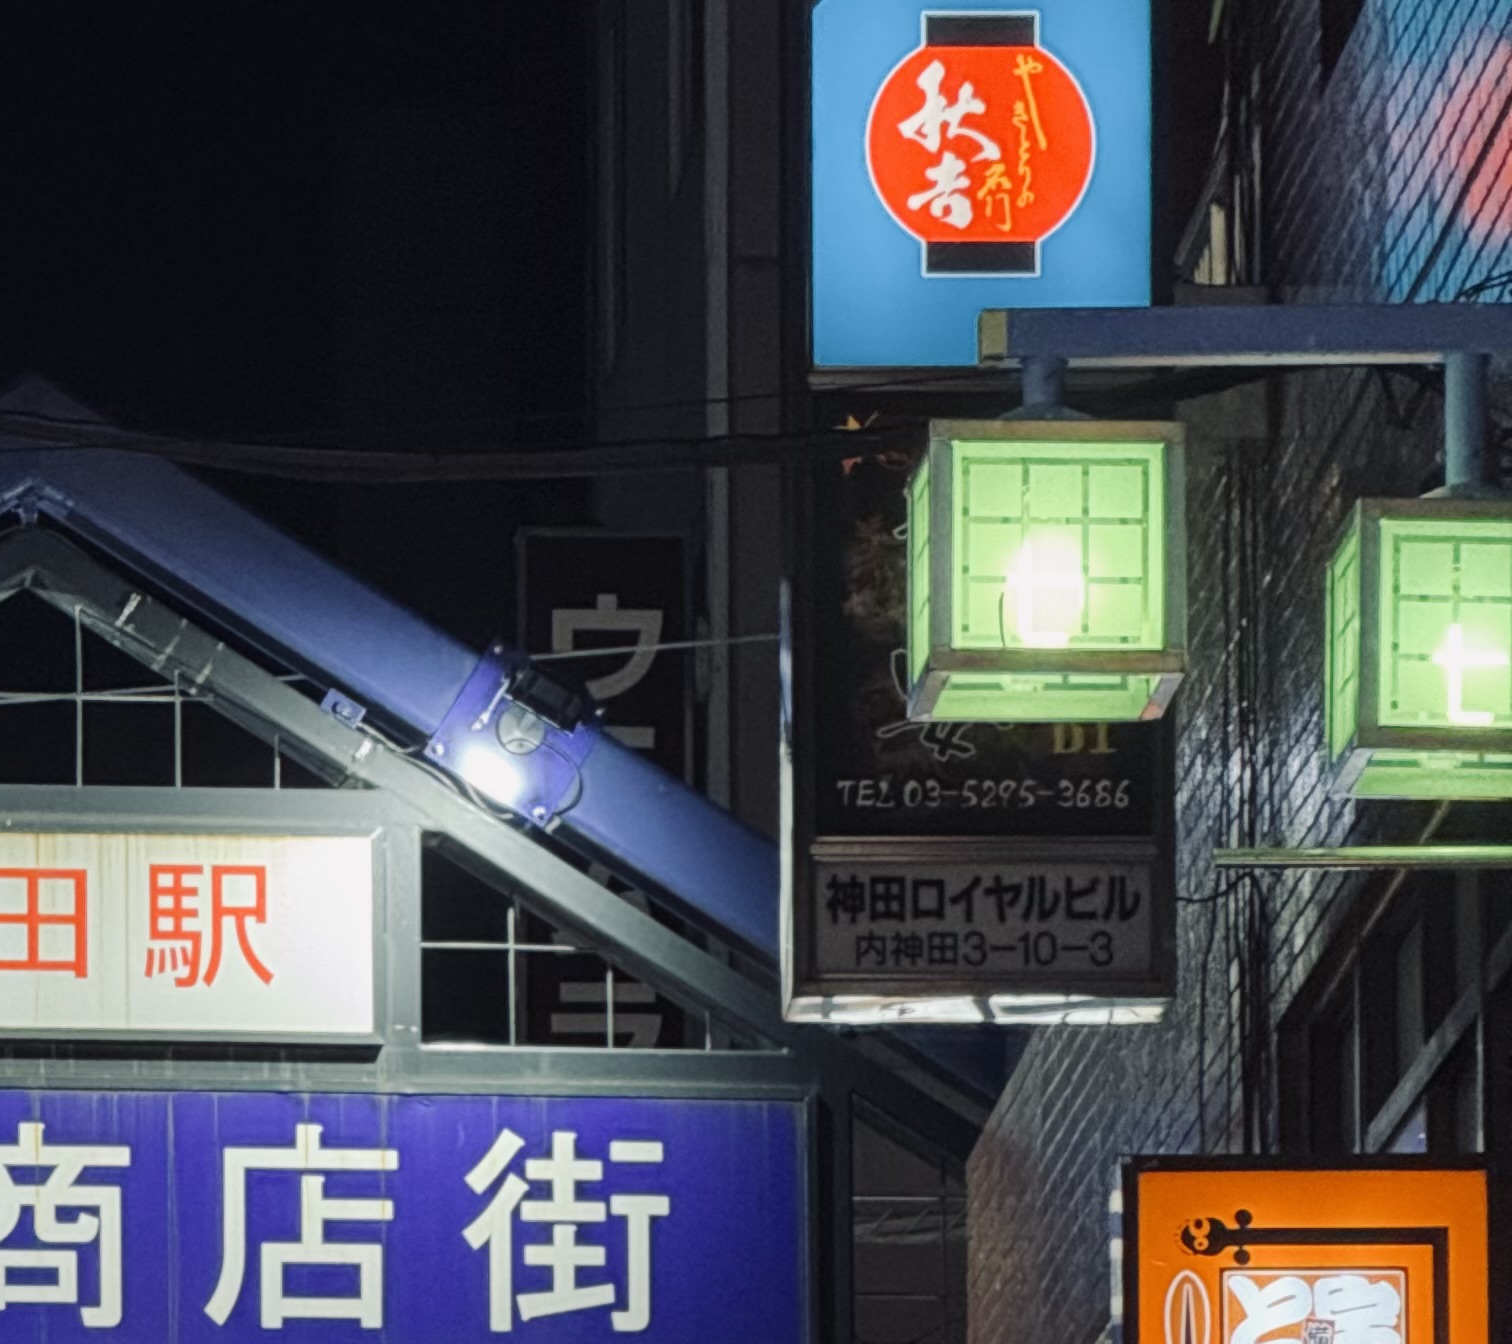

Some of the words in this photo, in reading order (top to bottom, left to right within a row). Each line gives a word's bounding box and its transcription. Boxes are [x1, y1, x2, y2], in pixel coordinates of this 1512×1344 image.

[896, 58, 1001, 230] 秋吉
[836, 779, 895, 808] TEL
[826, 874, 1141, 924] 神田ロイヤルビル
